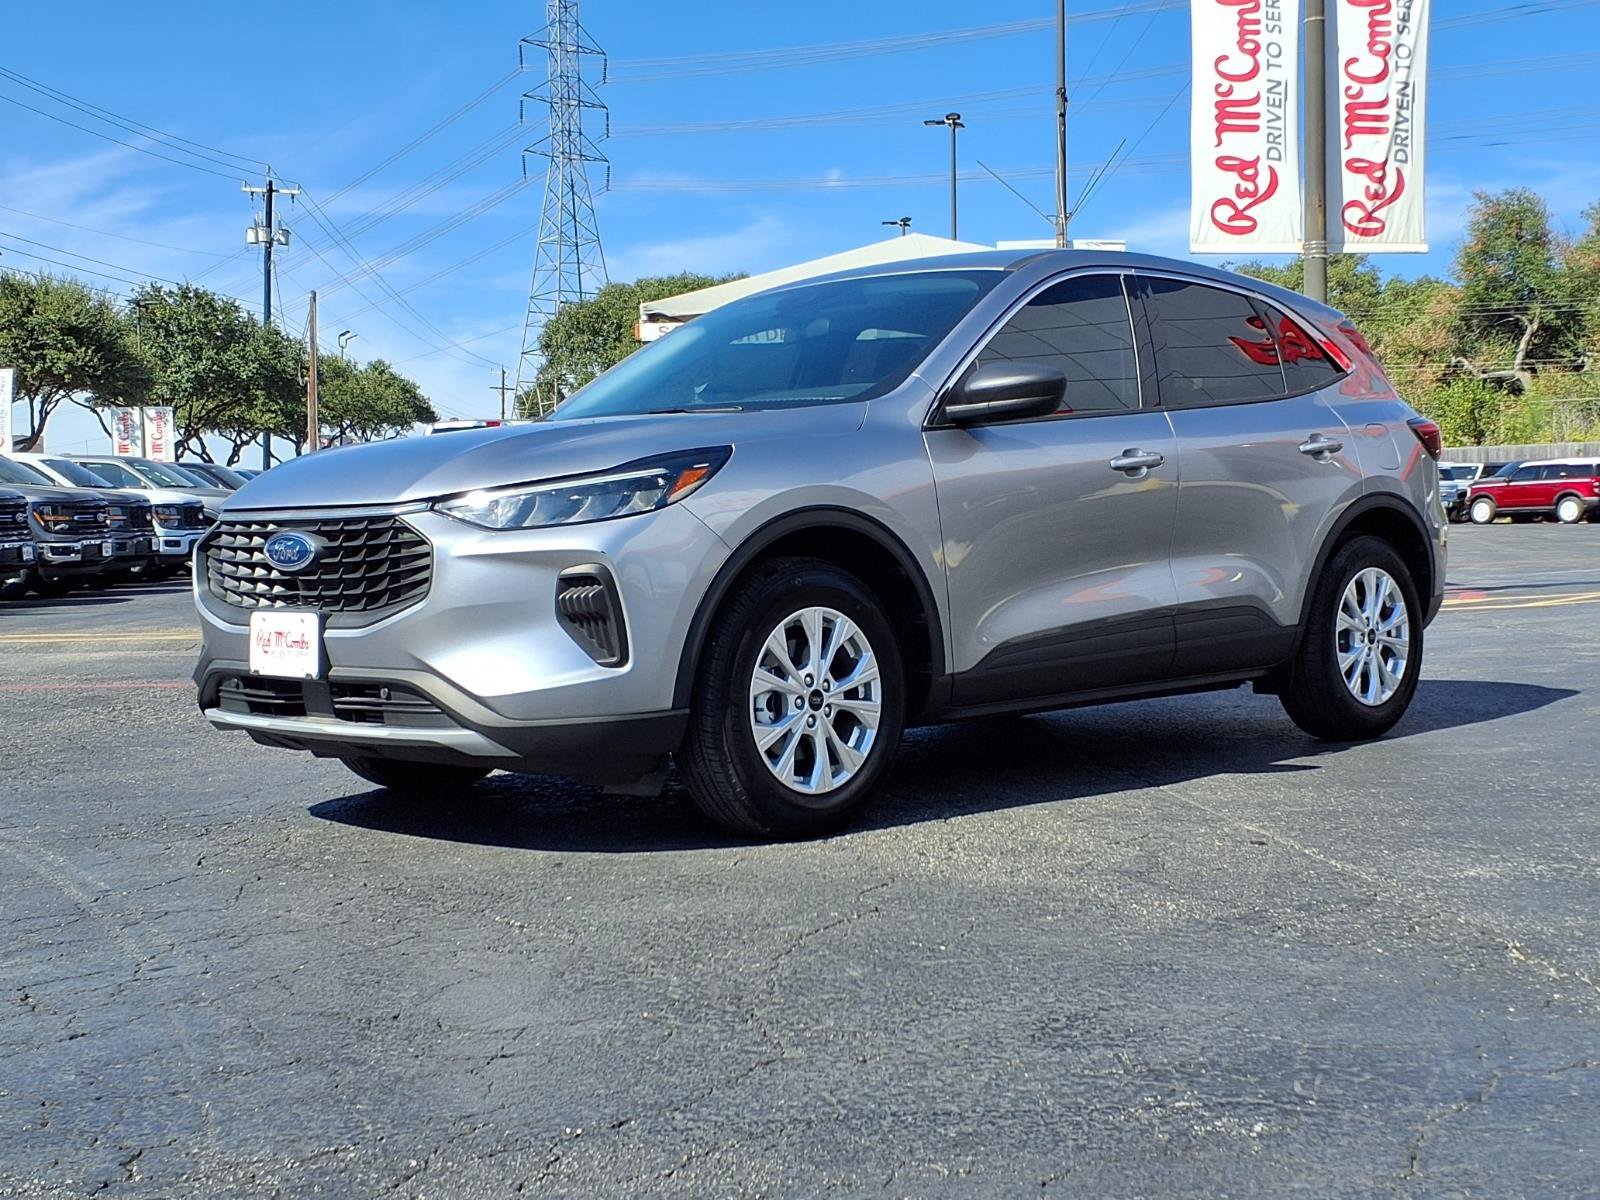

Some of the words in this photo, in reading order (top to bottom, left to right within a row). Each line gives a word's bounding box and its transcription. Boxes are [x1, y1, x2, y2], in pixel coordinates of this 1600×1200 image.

[1266, 42, 1282, 71] TO
[1395, 43, 1411, 72] TO
[1266, 79, 1282, 162] DRIVEN
[1394, 81, 1411, 164] DRIVEN
[1211, 155, 1279, 235] Red
[1341, 157, 1405, 237] Red
[273, 539, 300, 561] Ford
